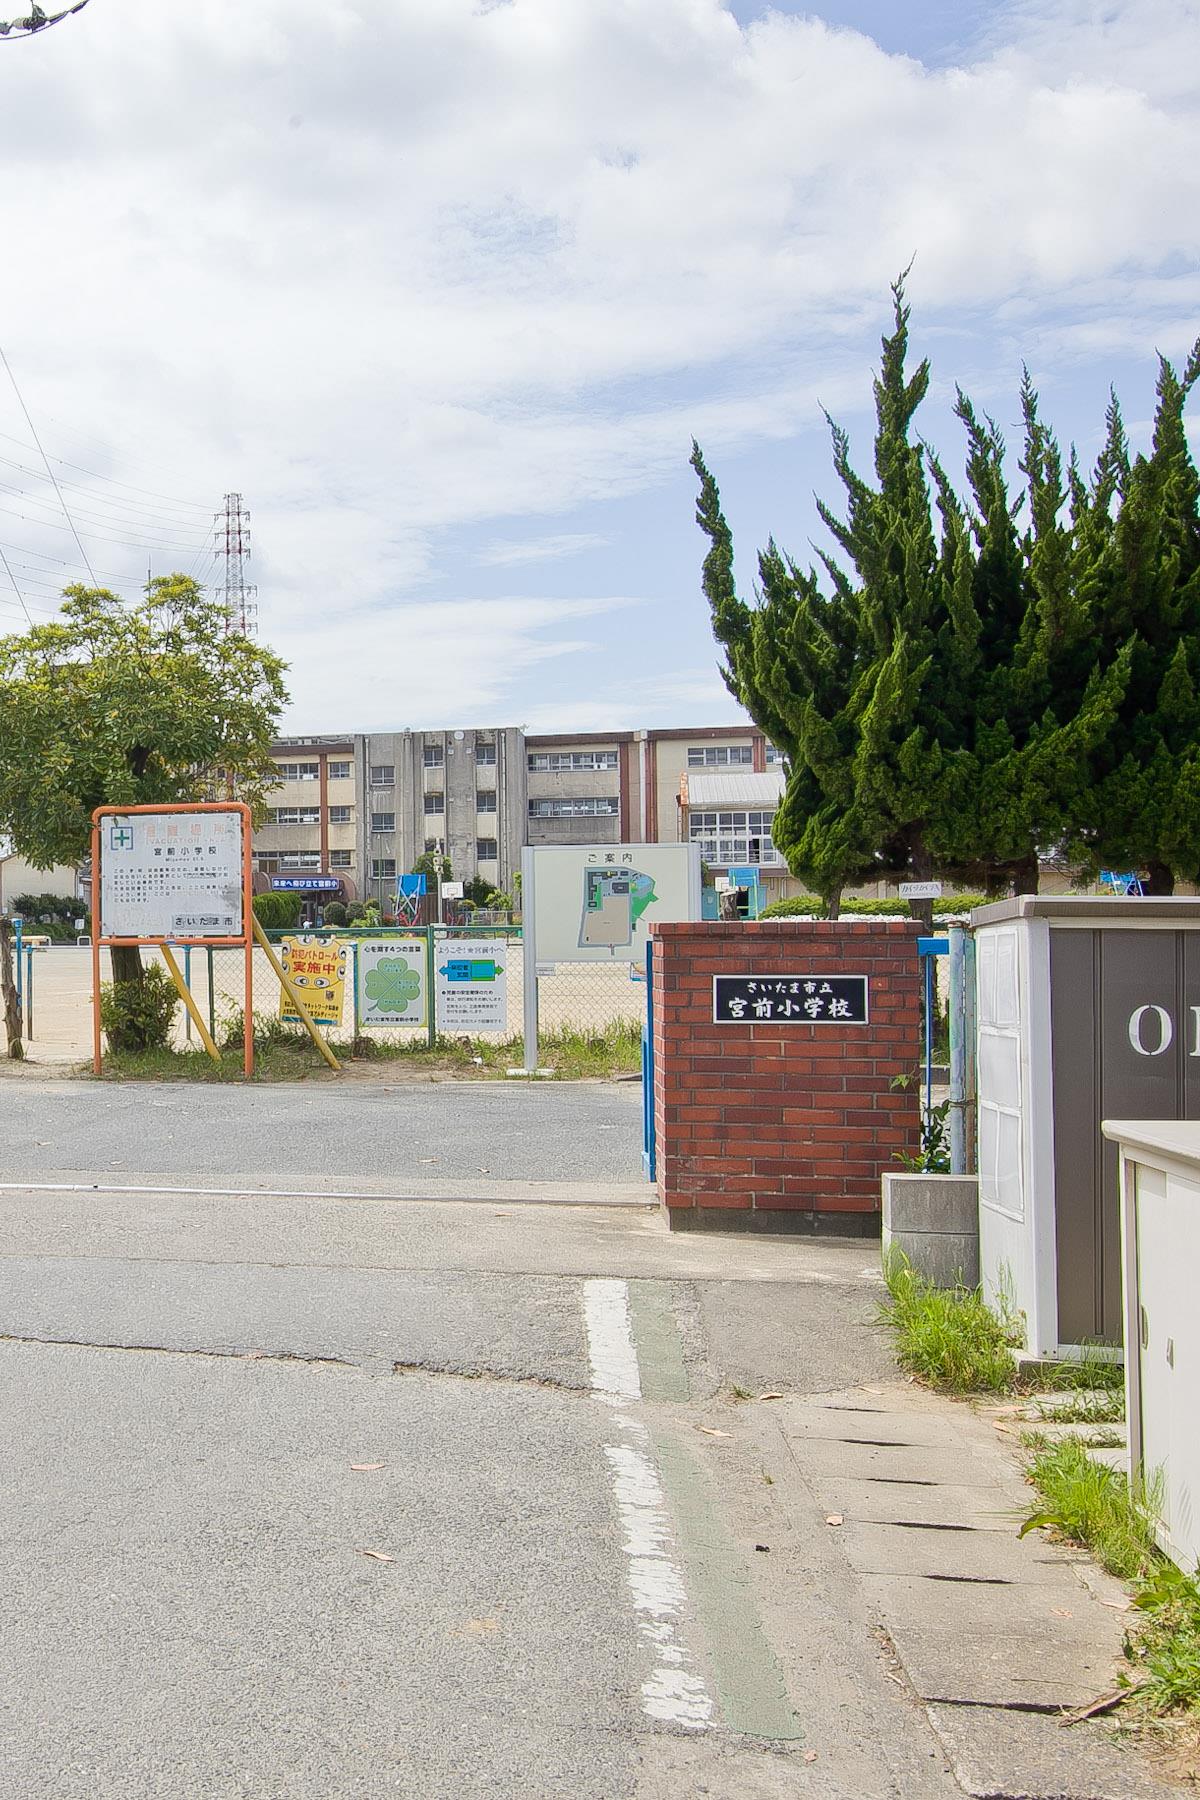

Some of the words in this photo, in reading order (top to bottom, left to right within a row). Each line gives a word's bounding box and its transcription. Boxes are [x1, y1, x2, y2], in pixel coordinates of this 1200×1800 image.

[154, 846, 217, 856] 宮前小学校
[588, 853, 633, 863] ご案内
[175, 917, 233, 926] さいたま市
[291, 948, 339, 961] 防犯パトロール
[293, 961, 336, 975] 実施中
[747, 981, 834, 994] さいたま市立
[728, 996, 853, 1018] 宮前小学校
